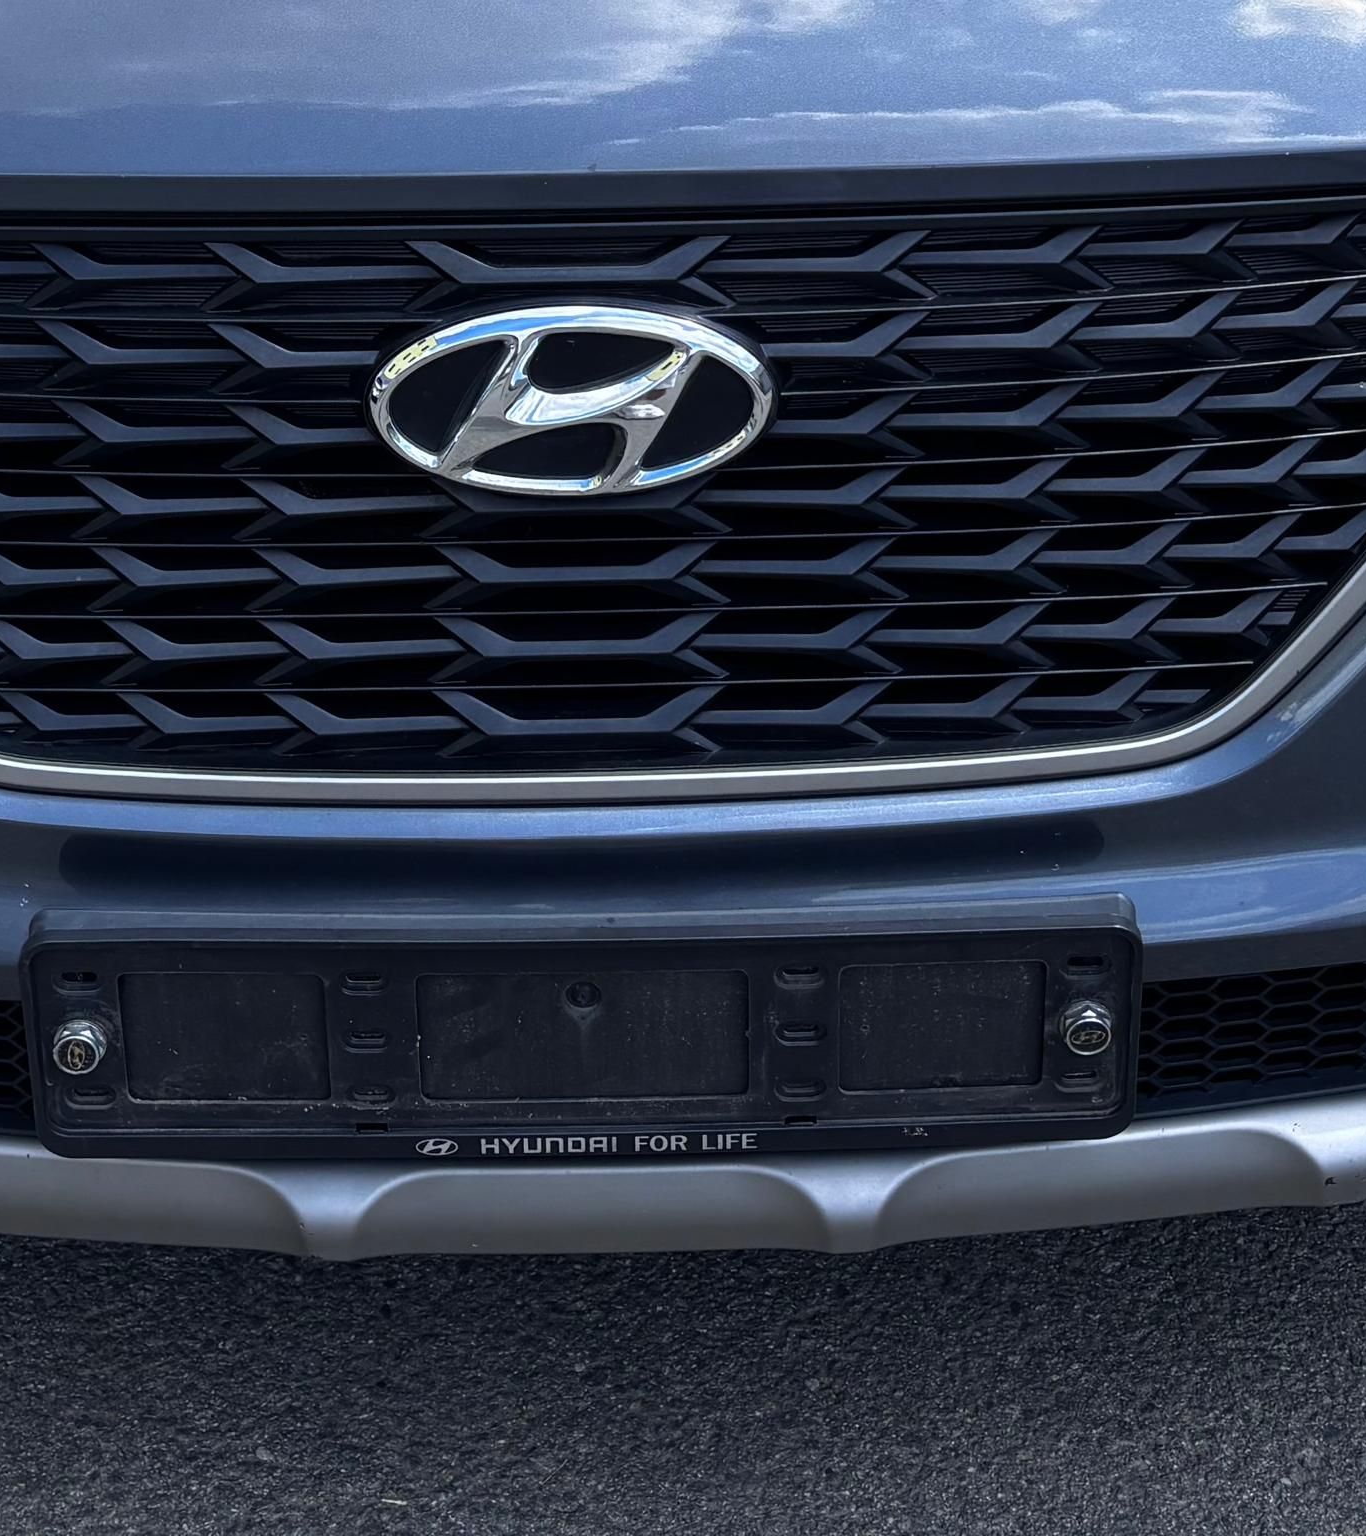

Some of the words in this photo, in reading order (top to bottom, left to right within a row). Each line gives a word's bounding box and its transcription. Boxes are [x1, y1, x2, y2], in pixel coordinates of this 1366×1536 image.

[480, 1136, 618, 1155] HYUNDAI
[634, 1135, 688, 1152] FOR
[702, 1133, 758, 1151] LIFE
